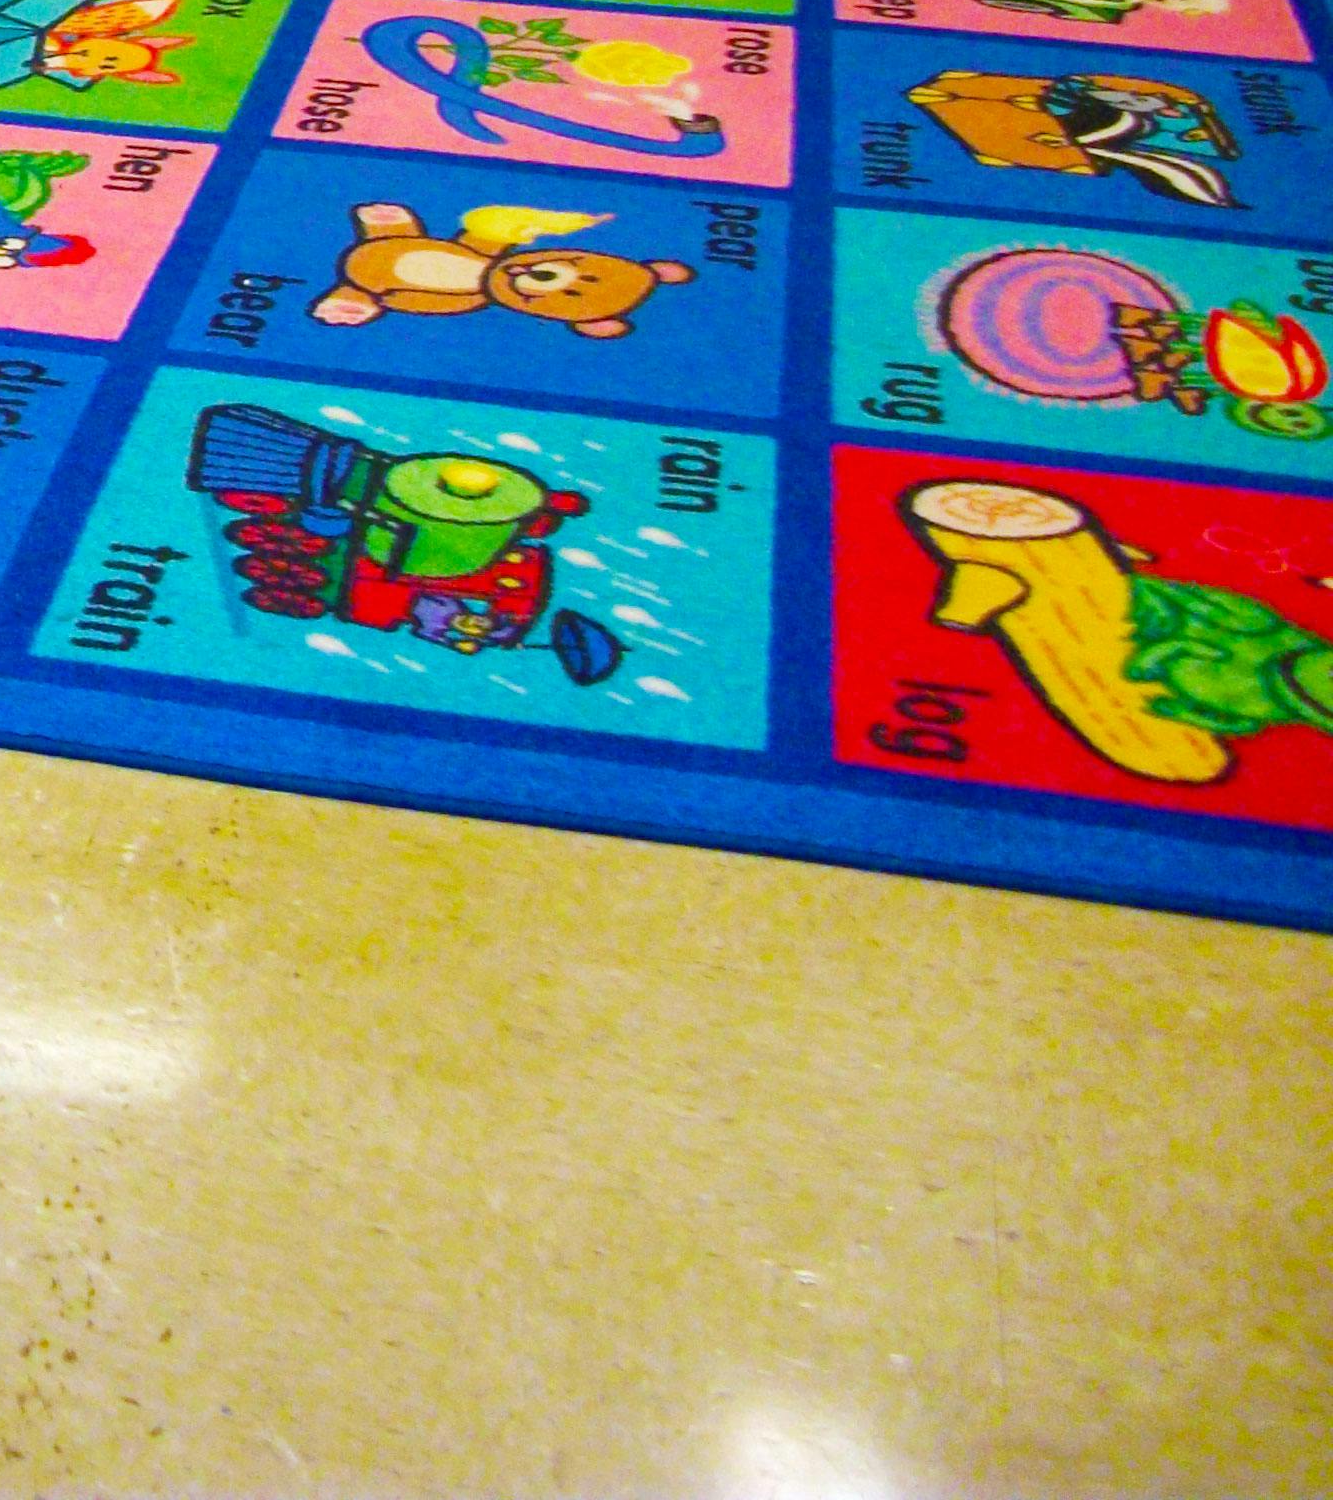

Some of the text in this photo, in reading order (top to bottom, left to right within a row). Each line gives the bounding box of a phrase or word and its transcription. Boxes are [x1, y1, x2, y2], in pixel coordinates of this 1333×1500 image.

[724, 26, 773, 76] rose
[300, 77, 380, 136] hose
[1235, 69, 1320, 137] skunk
[103, 144, 192, 194] hen
[860, 118, 932, 189] trunk
[692, 198, 762, 273] pear
[205, 271, 307, 349] bear
[861, 360, 946, 426] rug
[657, 435, 749, 514] rain
[70, 541, 192, 654] train
[868, 678, 993, 764] log
